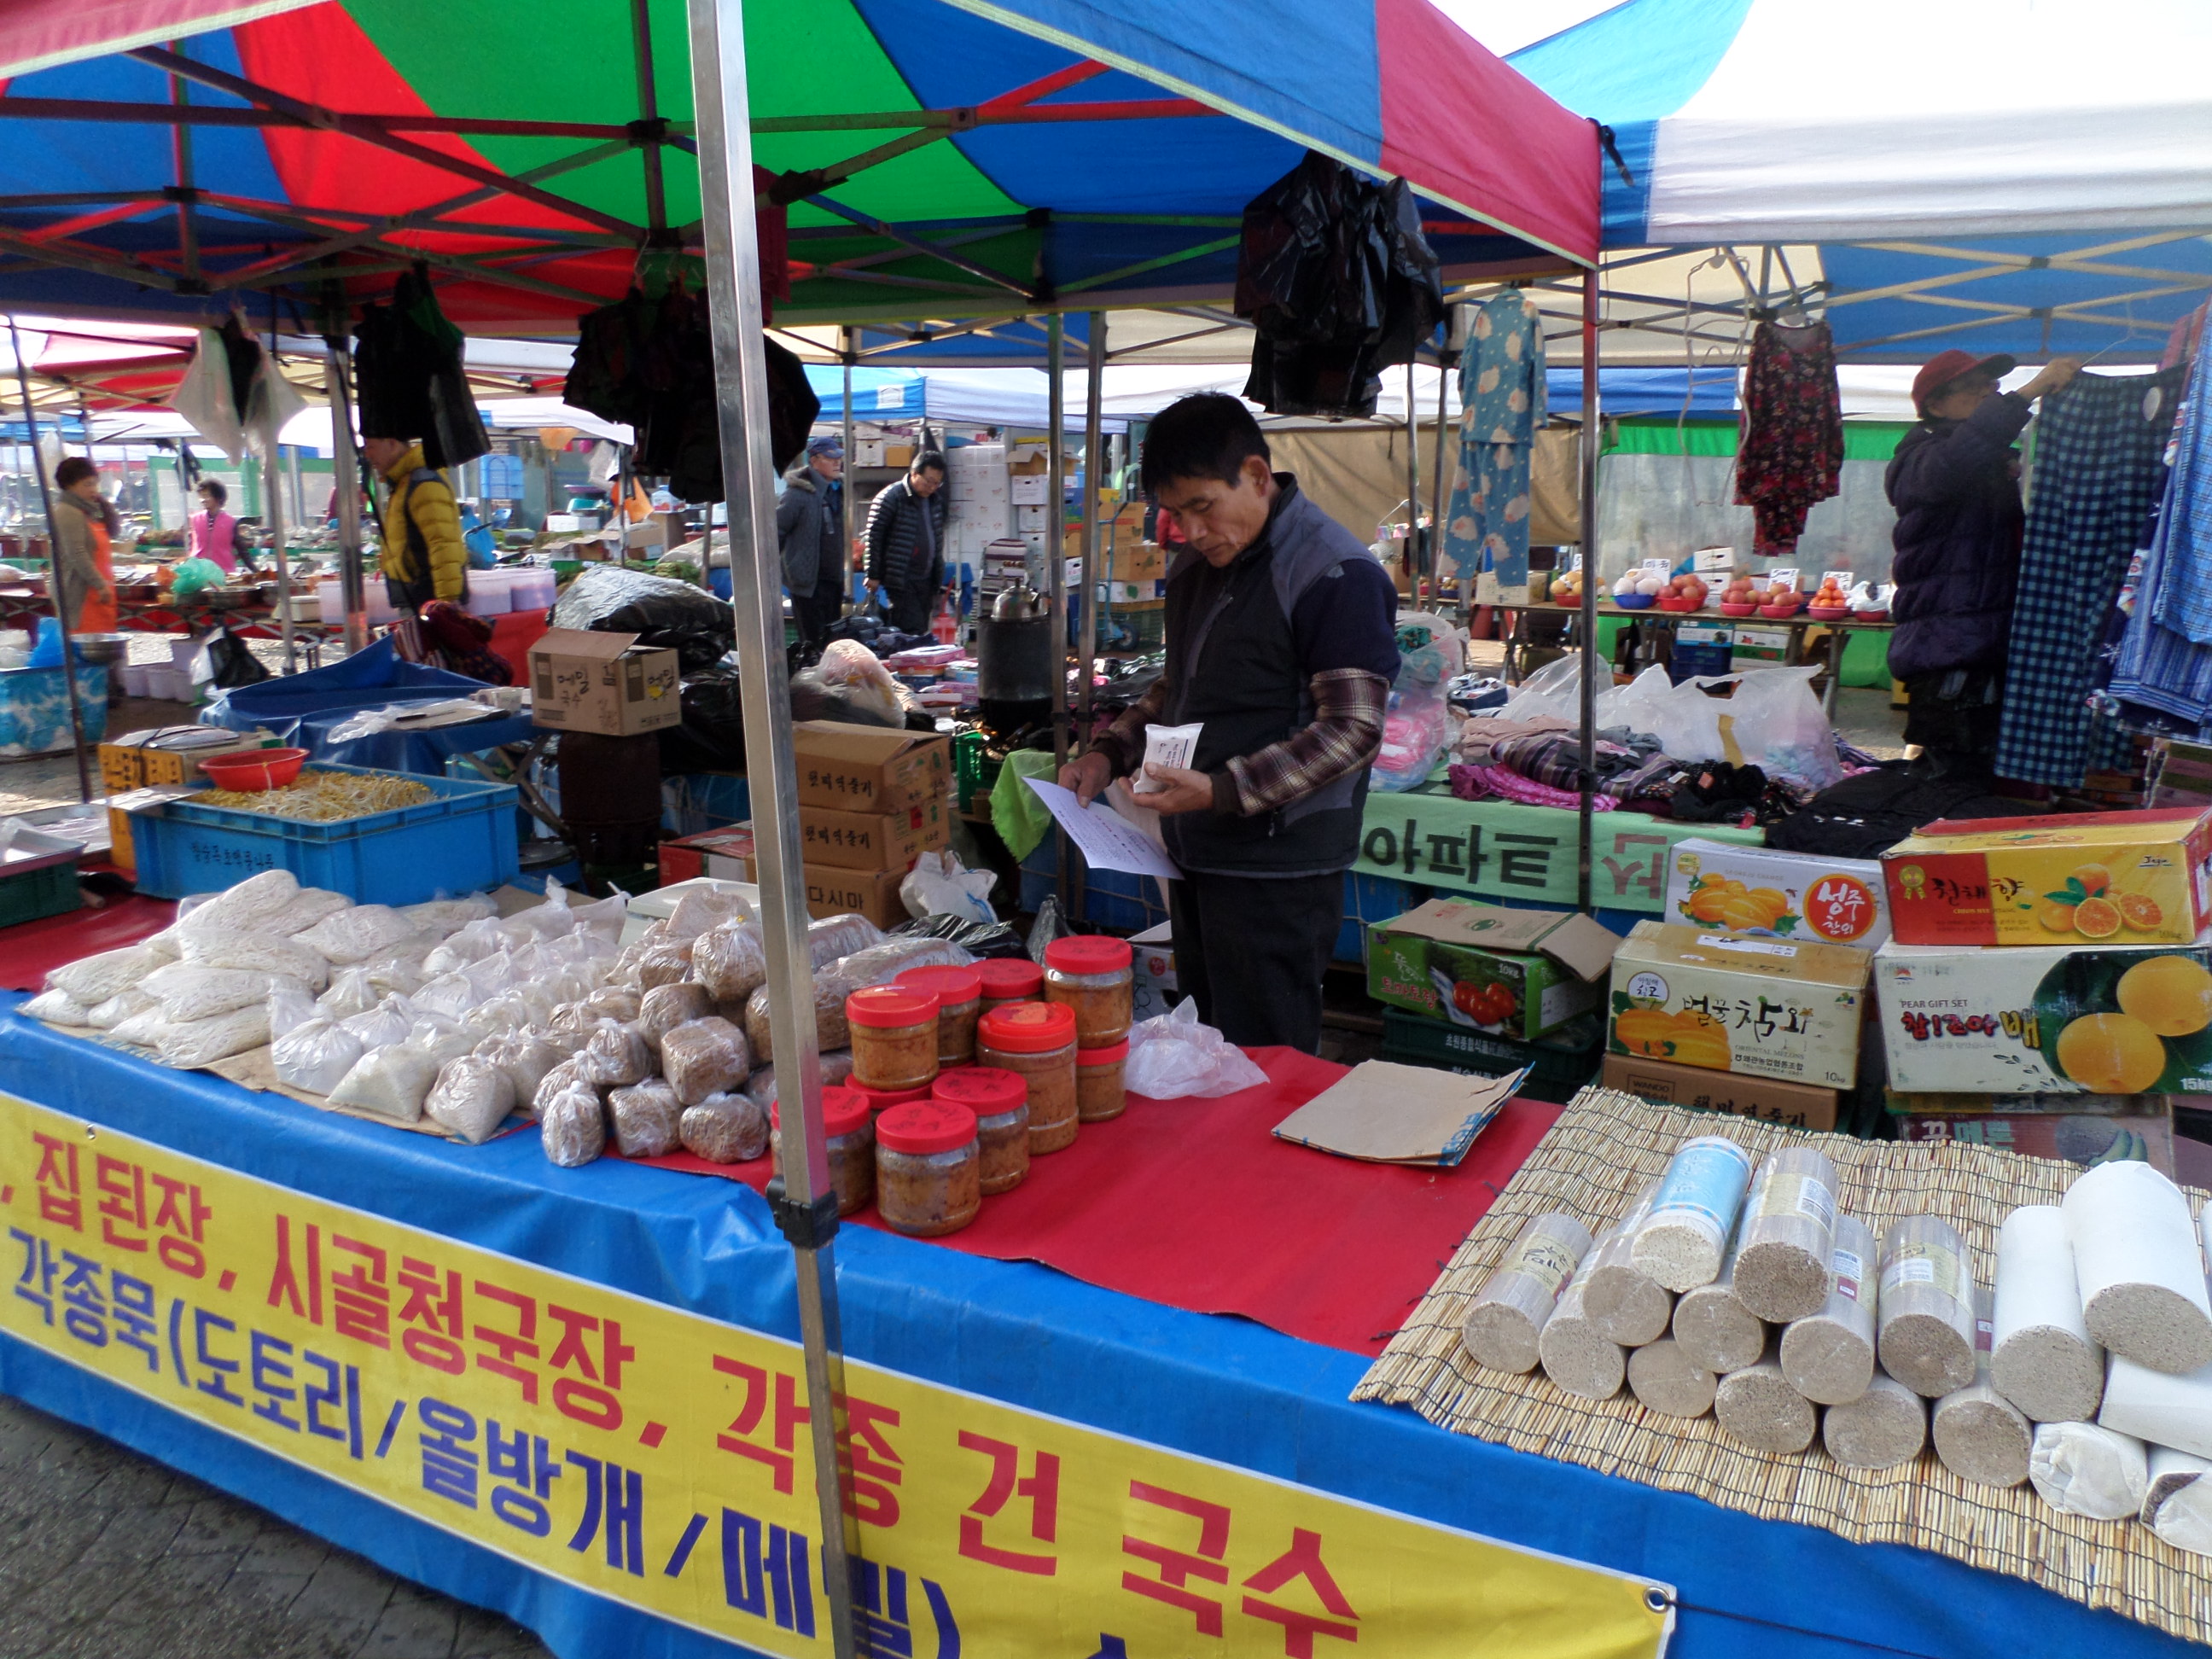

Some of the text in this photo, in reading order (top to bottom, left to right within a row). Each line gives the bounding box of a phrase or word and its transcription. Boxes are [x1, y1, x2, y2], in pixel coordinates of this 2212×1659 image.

[807, 886, 864, 910] 다시마
[1818, 882, 1866, 922] 성주
[1822, 916, 1854, 935] 참외
[1901, 999, 1968, 1009] PEAR GIFT SET
[1735, 1045, 1804, 1060] ORIENTAL MELONS
[1825, 1071, 1846, 1084] 10kg
[2181, 1078, 2212, 1092] 15kg
